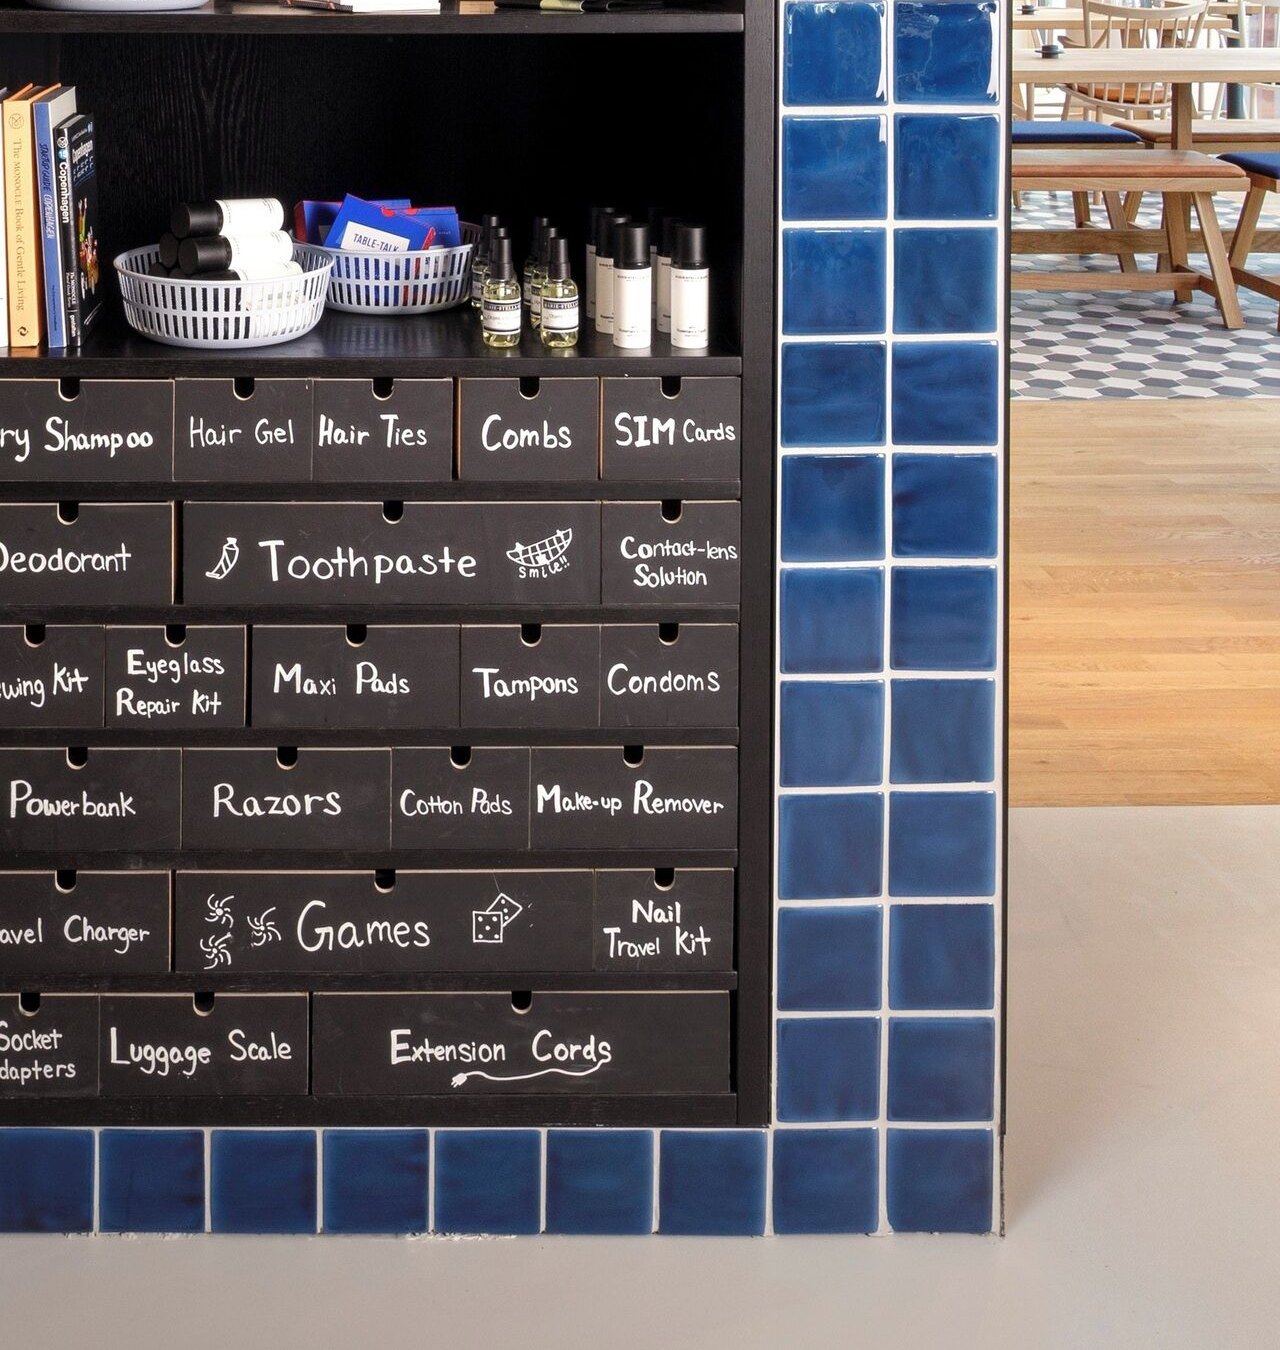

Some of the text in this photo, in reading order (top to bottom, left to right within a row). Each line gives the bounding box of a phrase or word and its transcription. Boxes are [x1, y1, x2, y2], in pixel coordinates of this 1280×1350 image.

[58, 162, 70, 224] Copenhagen
[13, 139, 26, 311] The MONOCLE Book of Gentle Living
[43, 194, 56, 240] COPENHAGEN
[353, 233, 400, 252] TABLE-TALK
[44, 416, 154, 458] Shampoo
[190, 415, 295, 448] Hair Gel
[318, 414, 428, 448] Hair Ties
[481, 414, 572, 451] Combs
[614, 412, 736, 448] SIM Cards
[258, 538, 477, 584] Toothpaste
[620, 536, 738, 560] Contact-lens
[633, 563, 708, 588] Solution
[52, 662, 89, 695] Kit
[126, 649, 225, 684] Eyeglass
[273, 662, 410, 695] Maxi Pads
[471, 667, 579, 701] Tampons
[607, 663, 721, 695] Condoms
[116, 687, 222, 718] Repair Kit
[10, 779, 136, 818] Powerbank
[213, 782, 342, 818] Razors
[400, 787, 513, 817] Cotton Pads
[536, 779, 725, 816] Make-up Remover
[296, 899, 431, 952] Games
[631, 899, 681, 924] Nail
[63, 914, 150, 953] Charger
[603, 925, 712, 958] Travel Kit
[110, 1026, 292, 1076] Luggage Scale
[390, 1028, 612, 1065] Extension Cords
